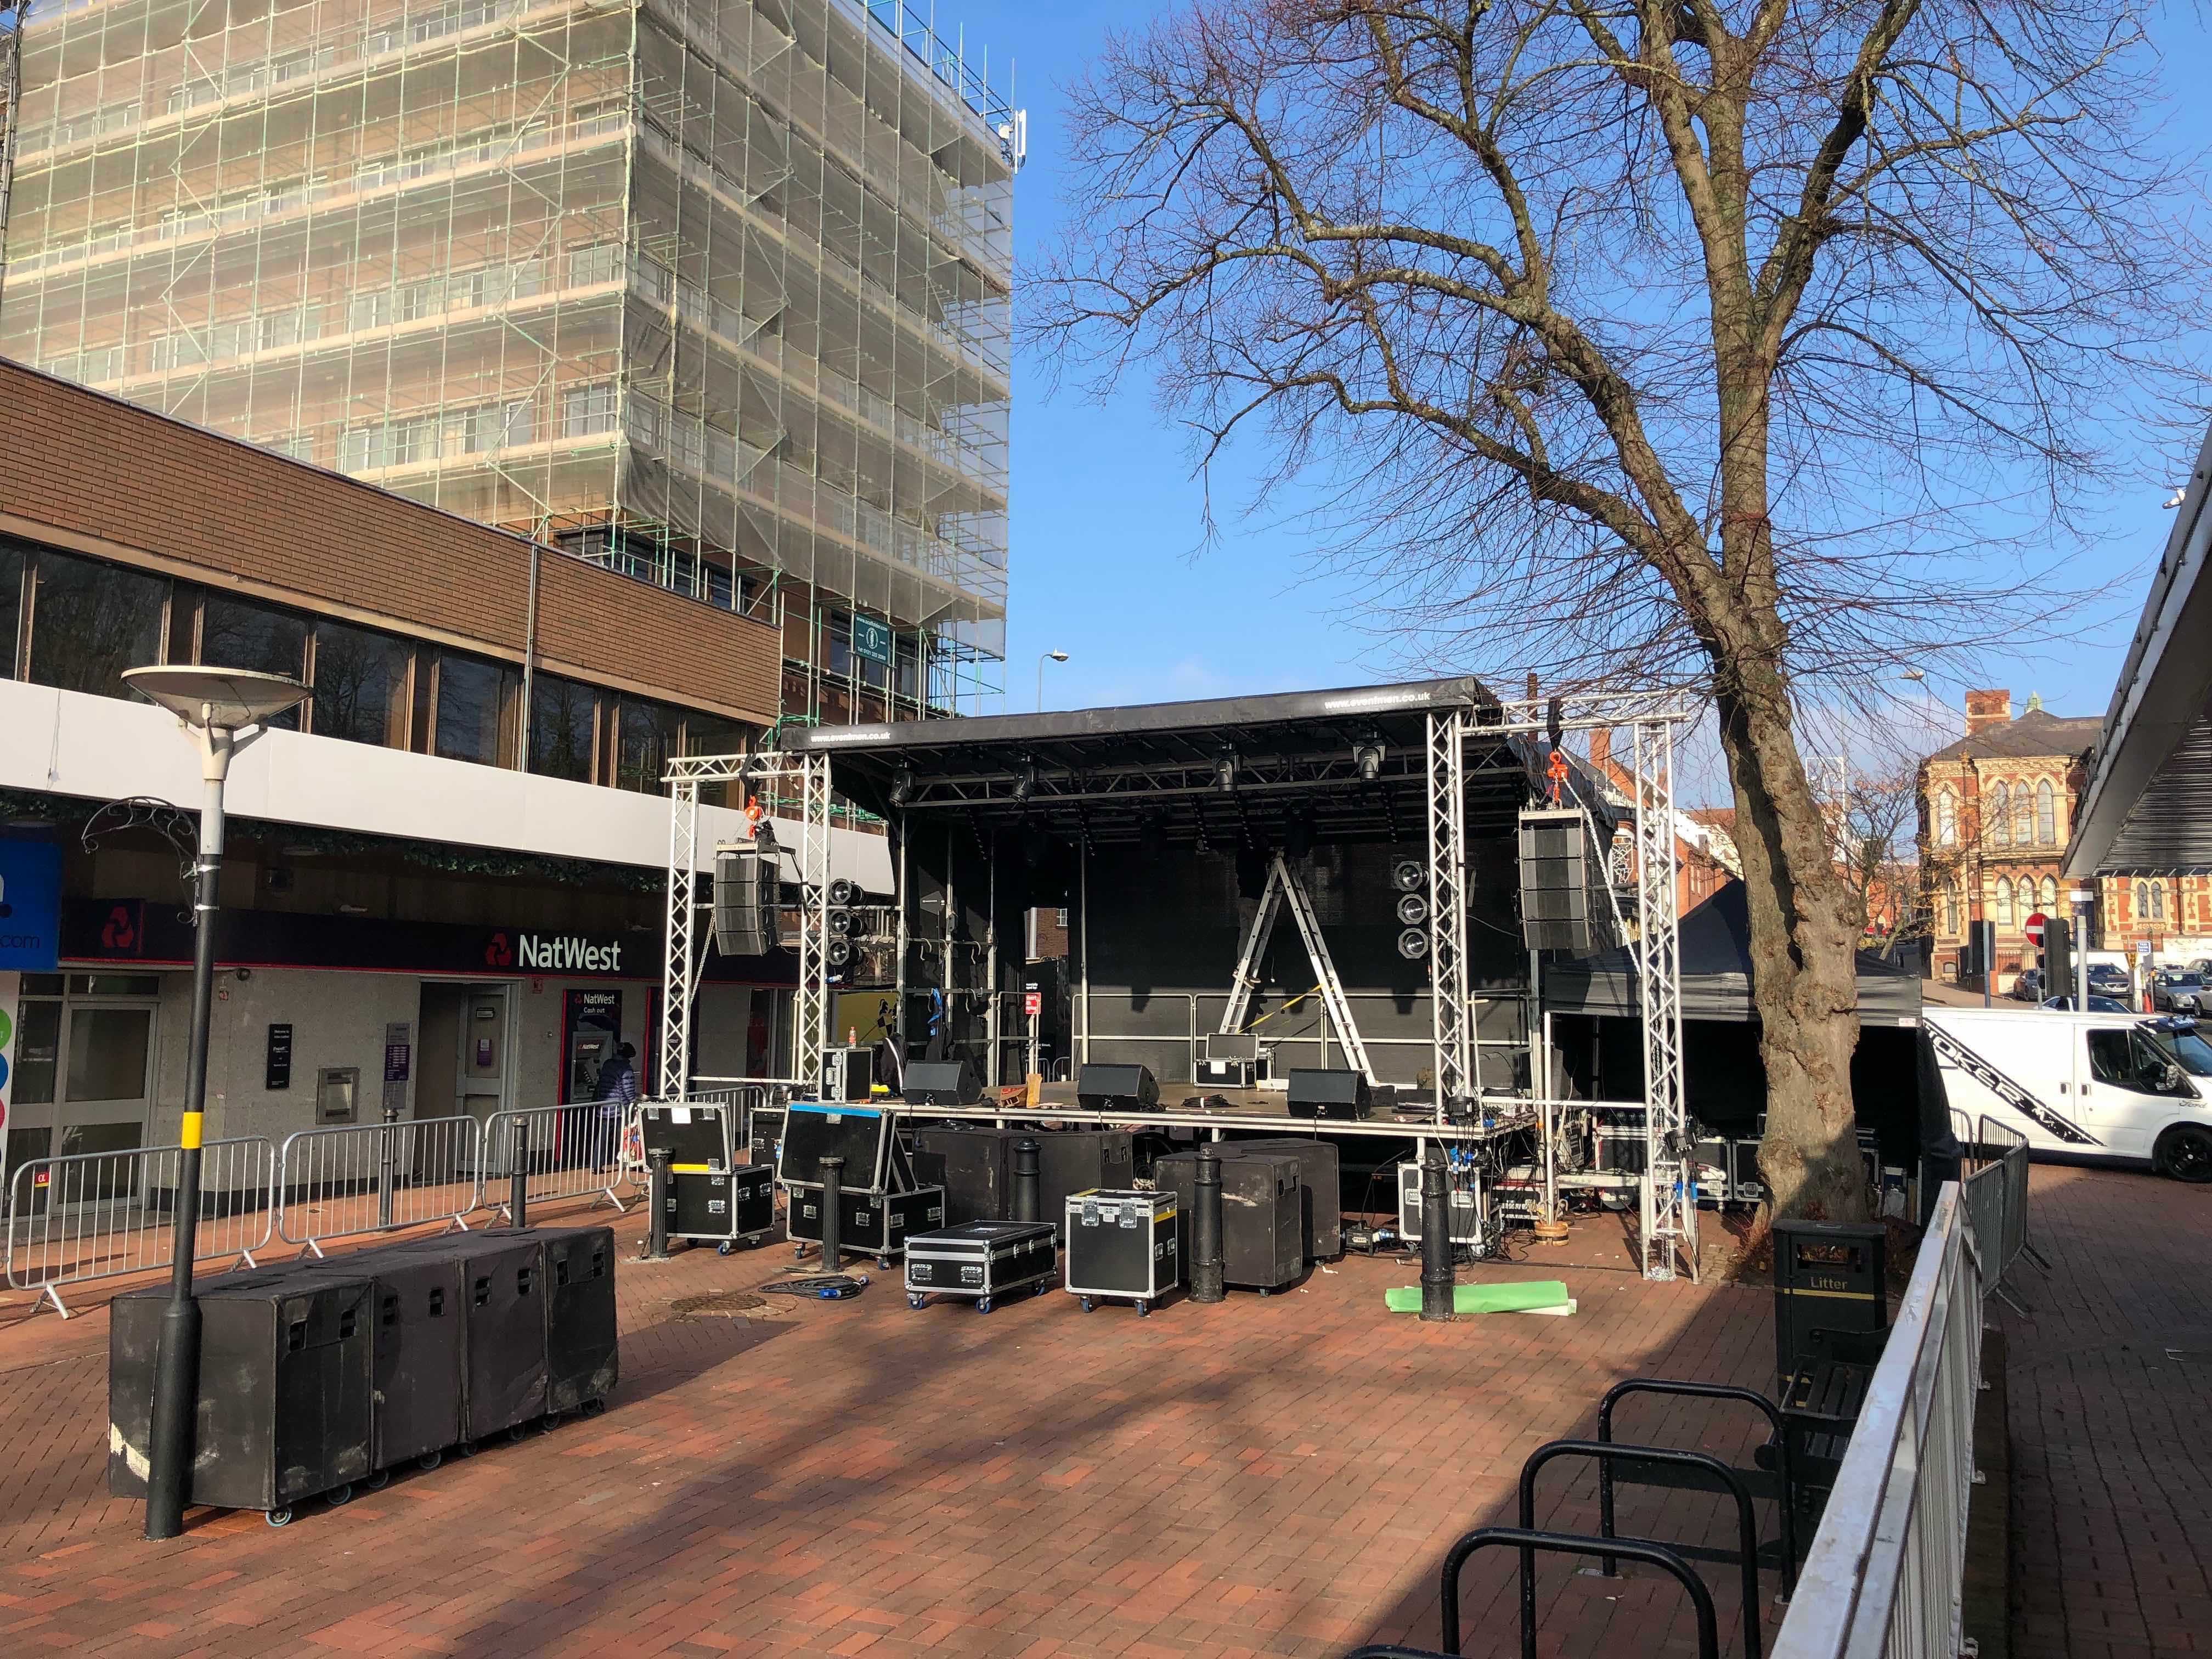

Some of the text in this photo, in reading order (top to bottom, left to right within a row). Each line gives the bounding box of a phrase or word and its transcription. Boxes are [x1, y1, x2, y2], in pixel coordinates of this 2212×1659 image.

[519, 934, 621, 971] NatWest
[584, 994, 614, 1004] NatWest
[2179, 1099, 2208, 1108] Ford
[1810, 1276, 1848, 1290] Litter
